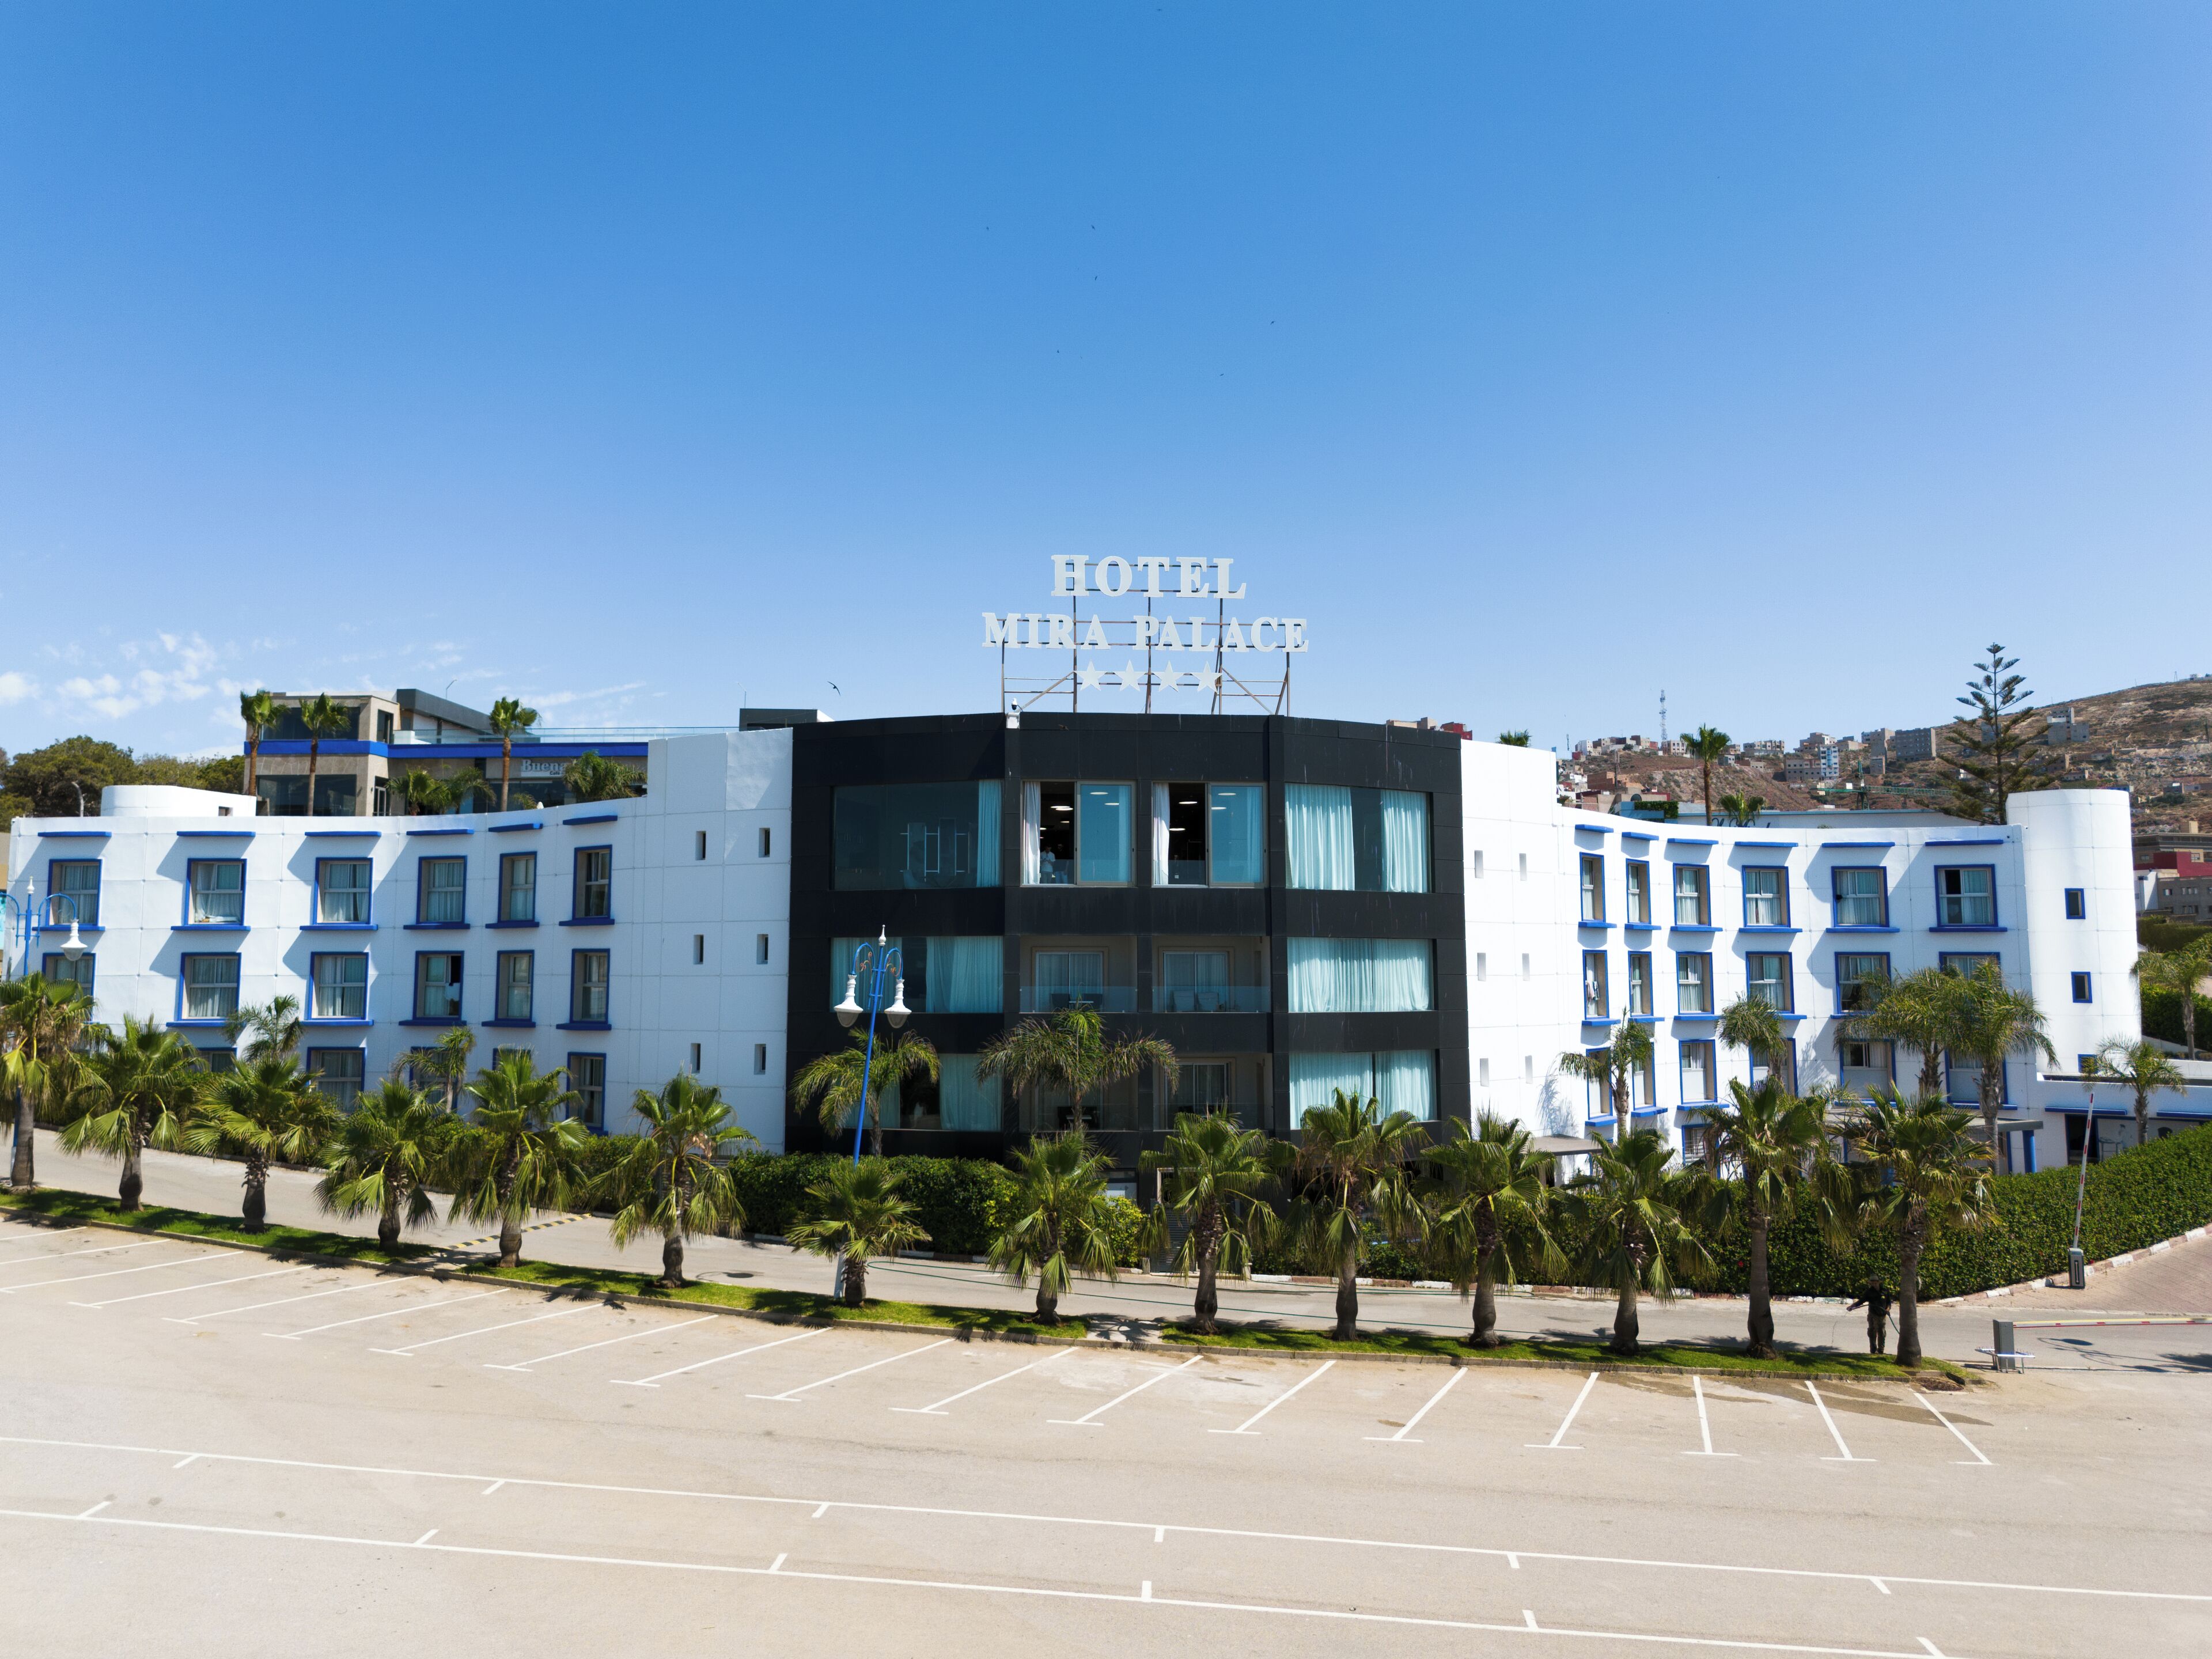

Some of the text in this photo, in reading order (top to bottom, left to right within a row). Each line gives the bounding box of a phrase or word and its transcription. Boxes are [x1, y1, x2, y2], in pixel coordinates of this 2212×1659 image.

[1051, 555, 1247, 599] HOTEL
[982, 612, 1309, 653] MIRA PALACE
